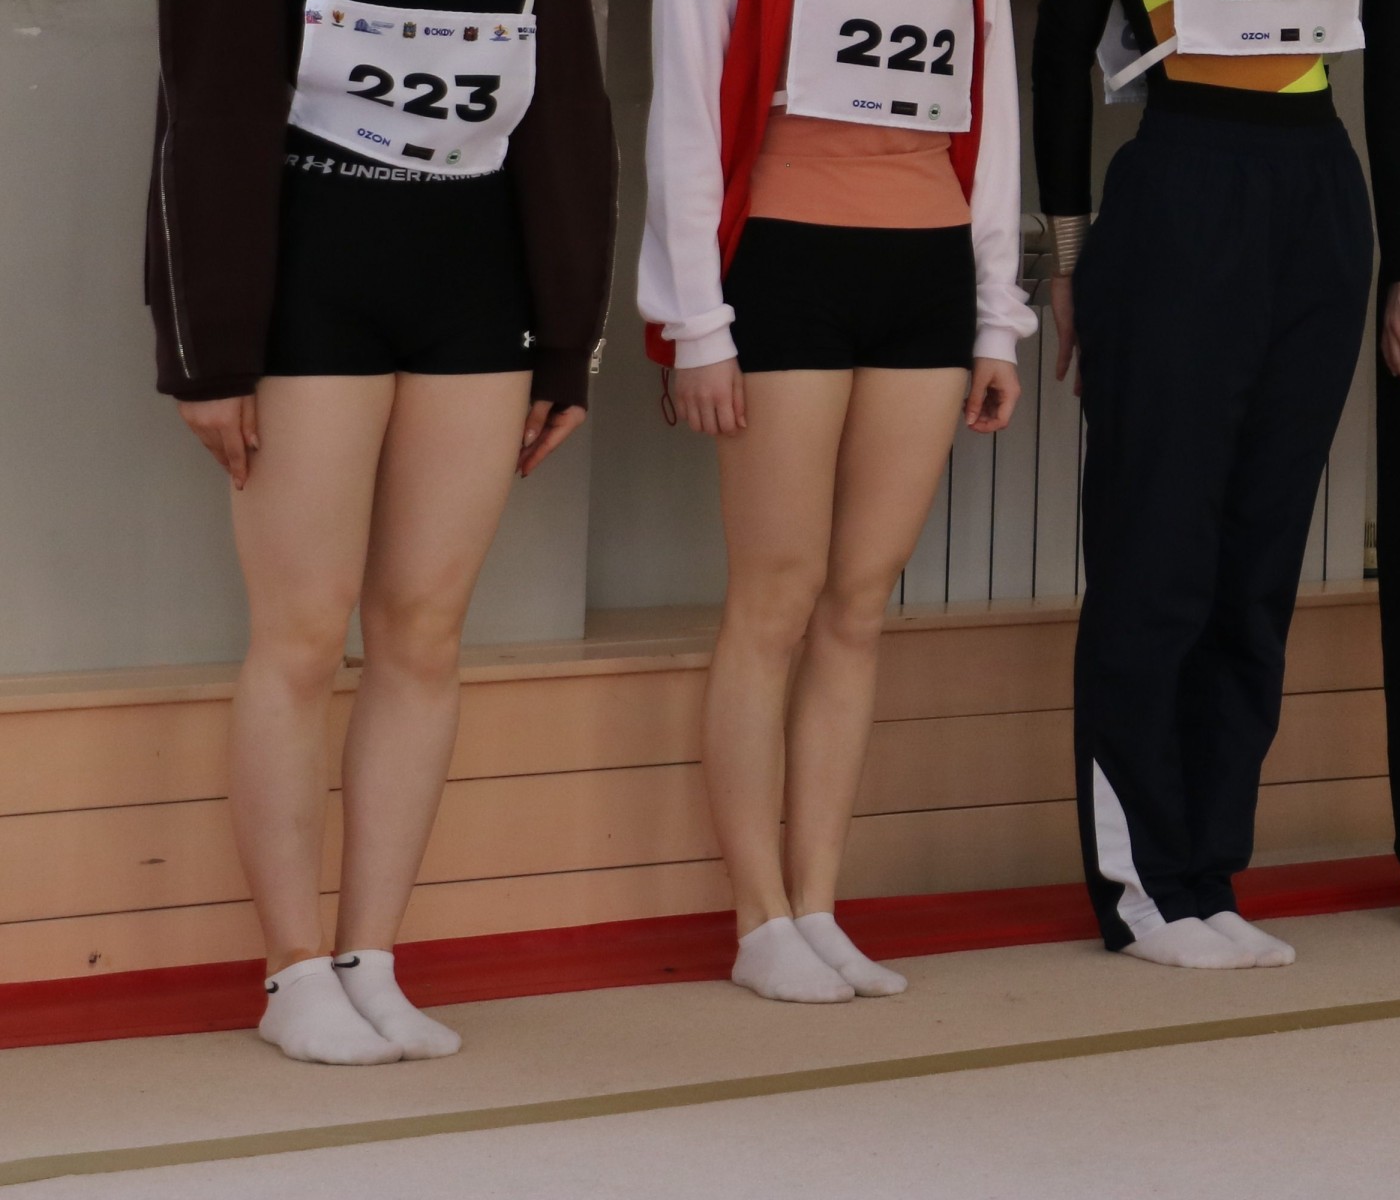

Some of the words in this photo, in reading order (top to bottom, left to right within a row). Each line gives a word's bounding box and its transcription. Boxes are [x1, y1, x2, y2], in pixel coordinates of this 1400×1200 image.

[431, 27, 455, 38] СКФУ
[1241, 32, 1270, 40] OZON
[836, 18, 955, 76] 222
[347, 64, 501, 123] 223
[853, 99, 882, 110] OZON
[357, 127, 391, 147] OZON
[340, 162, 421, 182] UNDER
